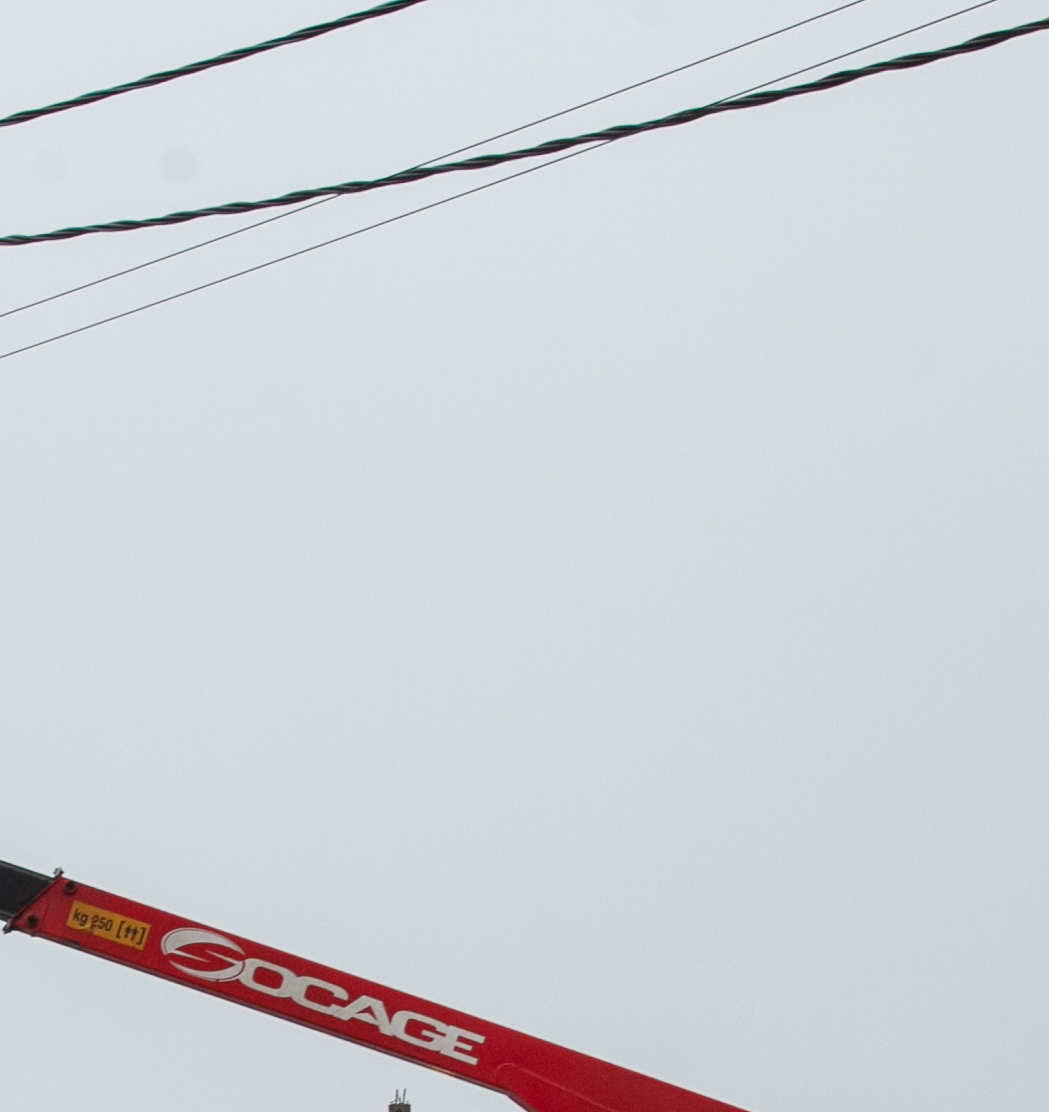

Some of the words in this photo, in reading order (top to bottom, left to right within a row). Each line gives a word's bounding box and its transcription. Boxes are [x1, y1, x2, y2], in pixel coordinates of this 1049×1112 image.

[72, 908, 89, 926] kg
[91, 915, 113, 932] 250
[160, 927, 486, 1066] SOCAGE
